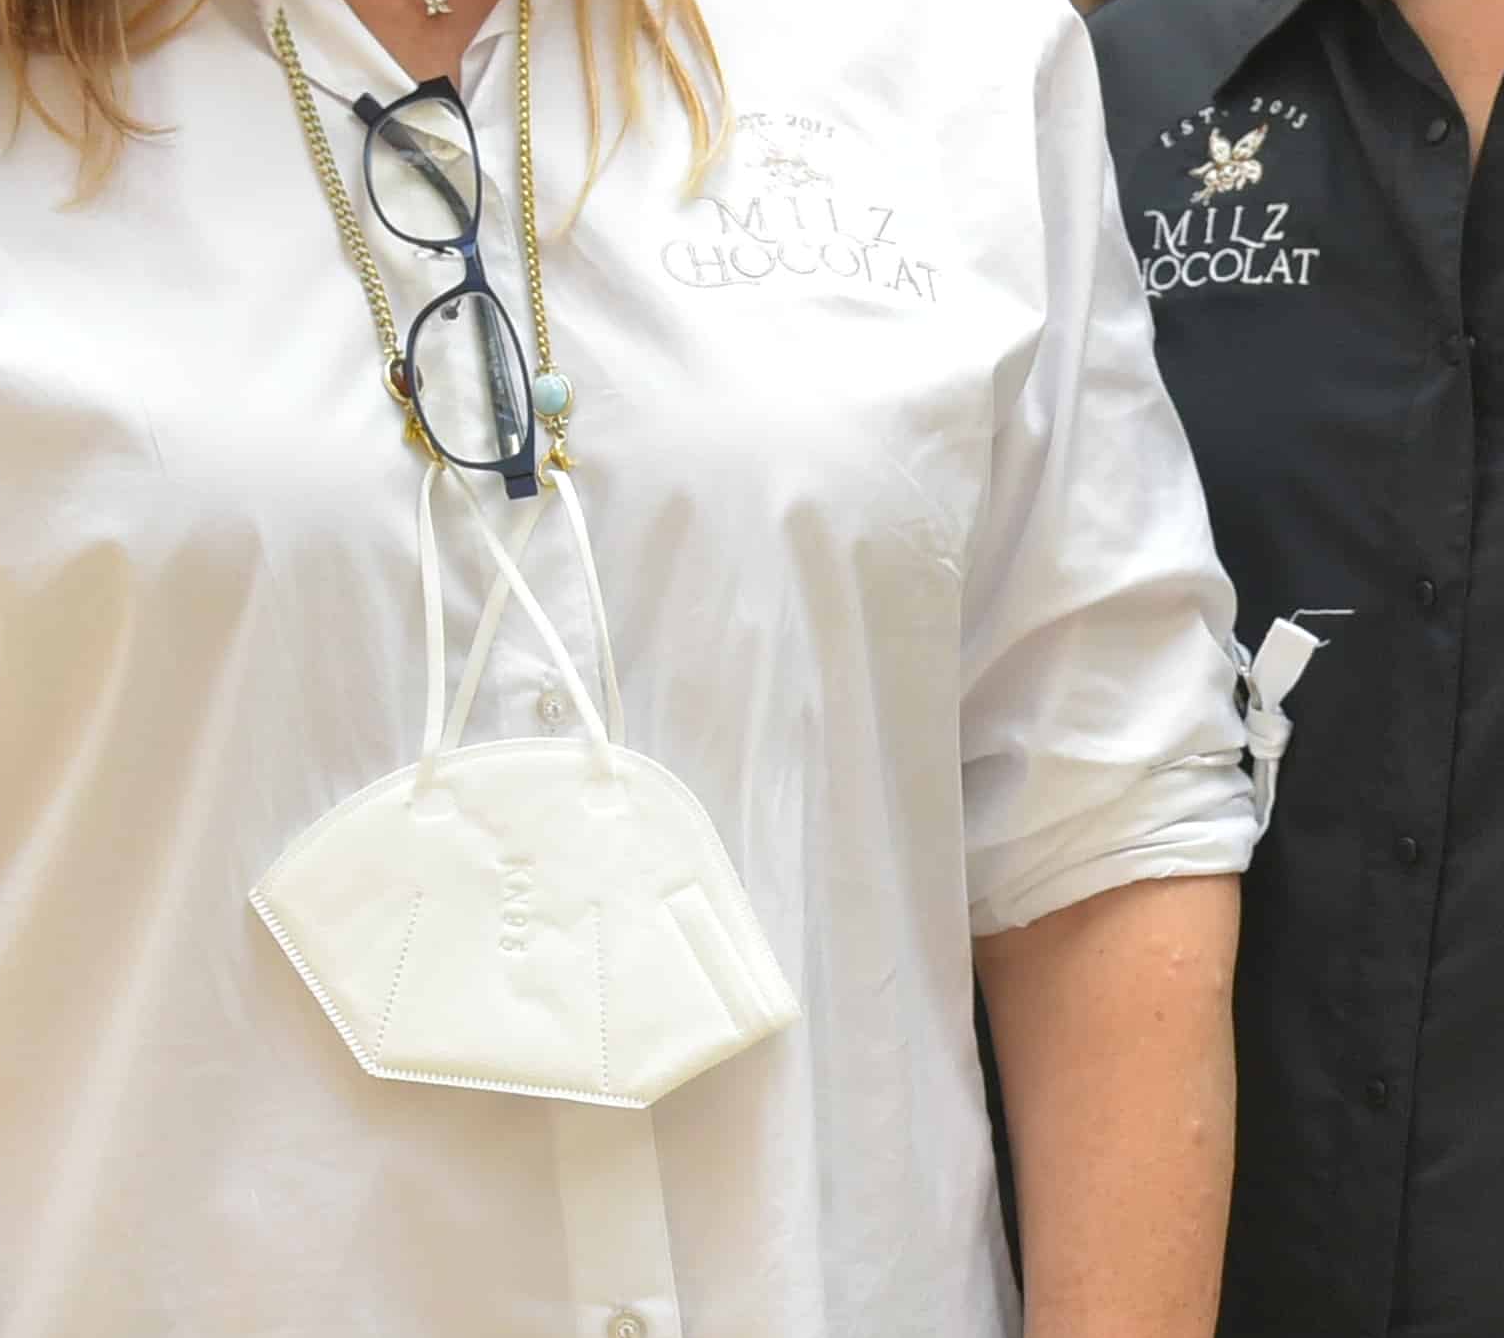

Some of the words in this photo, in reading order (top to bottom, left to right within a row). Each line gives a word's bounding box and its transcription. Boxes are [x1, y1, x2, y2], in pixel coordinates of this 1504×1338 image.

[1248, 95, 1310, 129] 2015
[1143, 202, 1289, 259] MILZ
[1140, 247, 1321, 298] OCOLAT
